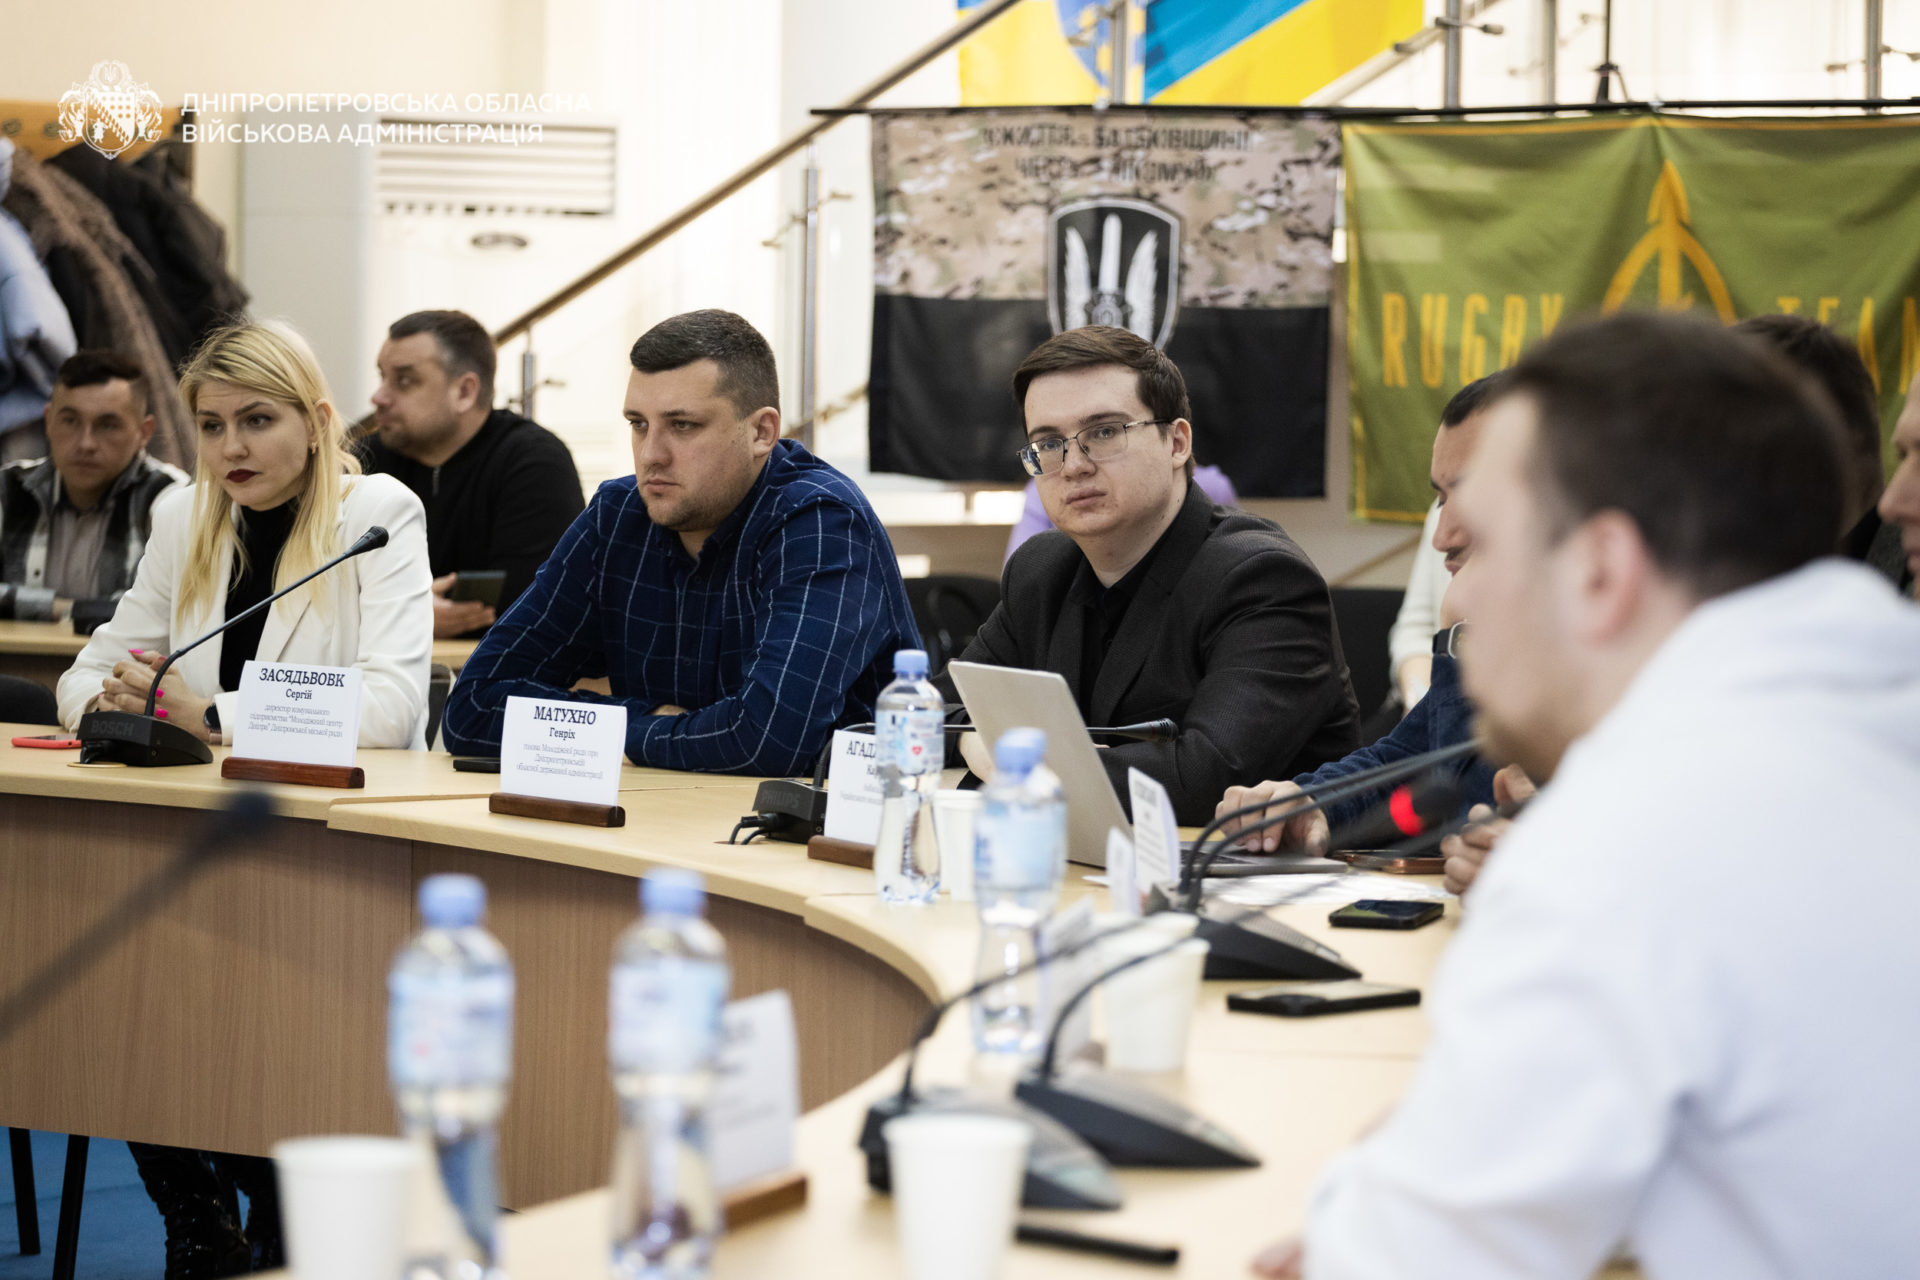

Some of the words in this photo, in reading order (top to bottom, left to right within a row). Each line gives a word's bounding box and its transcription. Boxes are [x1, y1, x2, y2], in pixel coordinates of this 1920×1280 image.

[259, 667, 346, 688] ЗАСЯДЬВОВК
[285, 688, 313, 701] Сергій
[533, 705, 597, 726] МАТУХНО
[90, 719, 135, 738] BOSCH
[549, 727, 576, 741] Генріх
